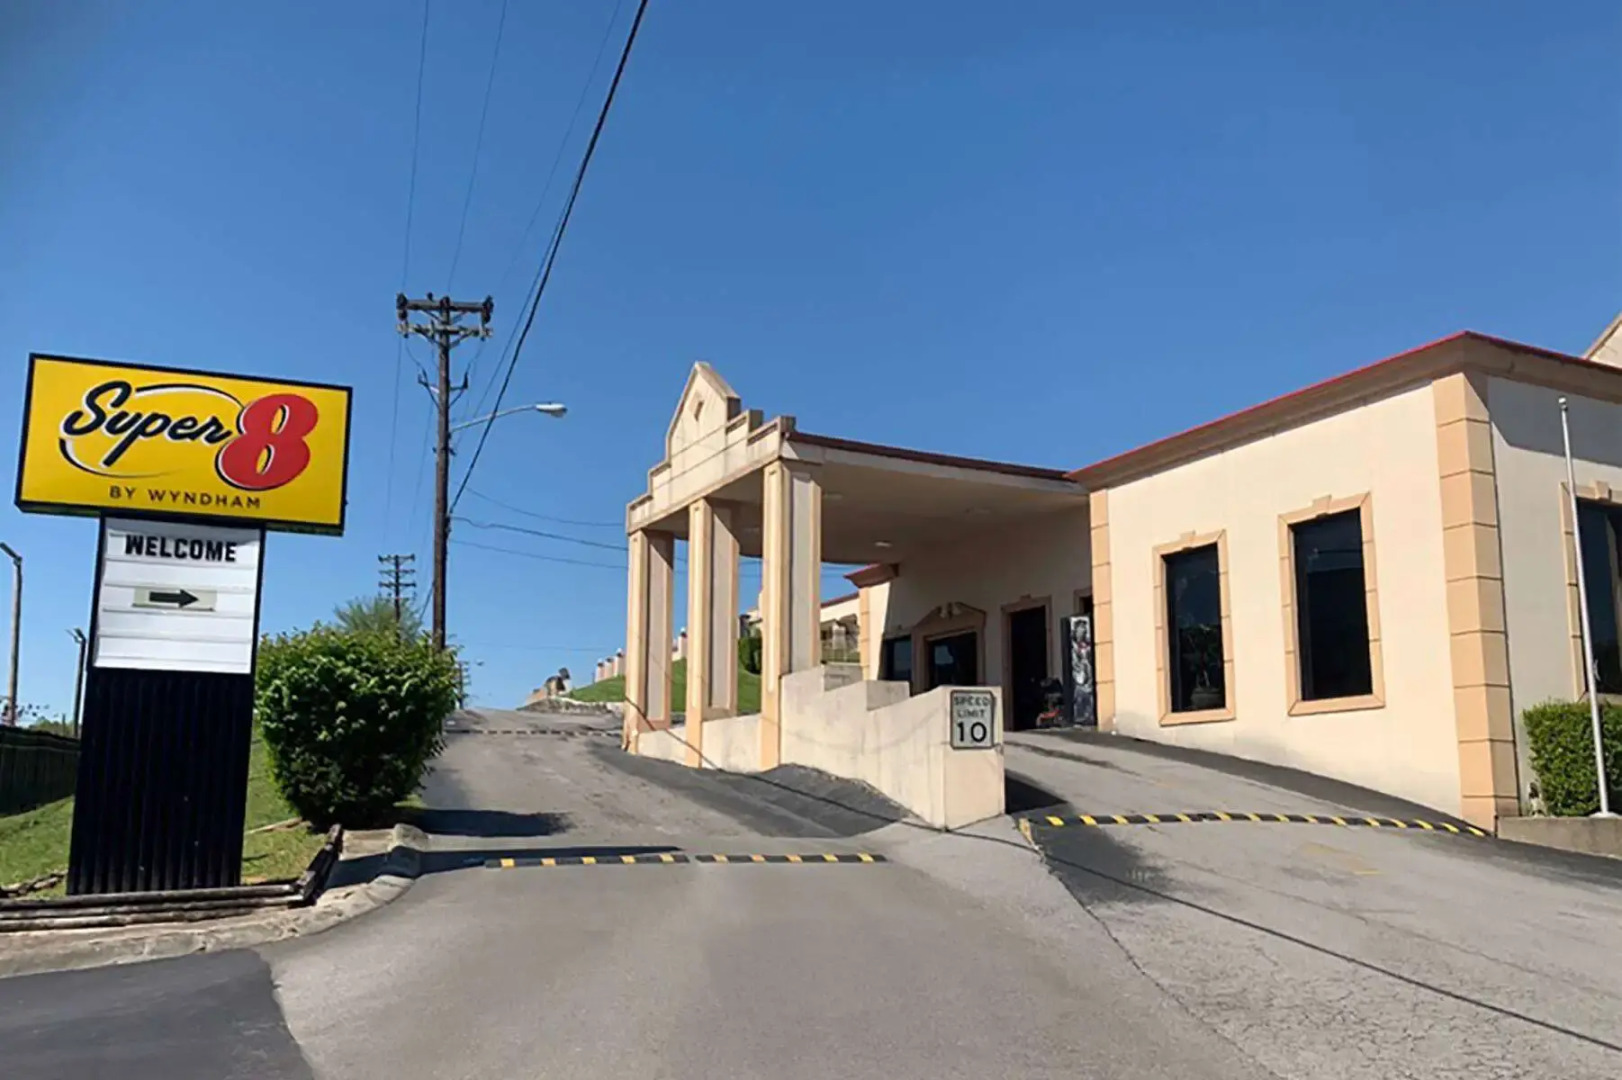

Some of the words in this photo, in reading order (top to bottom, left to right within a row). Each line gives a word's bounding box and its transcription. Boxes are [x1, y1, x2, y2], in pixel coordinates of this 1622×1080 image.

[62, 380, 233, 467] Super
[215, 393, 318, 491] 8
[109, 485, 136, 499] BY
[148, 489, 261, 509] WYNDHAM
[124, 534, 237, 562] WELCOME
[954, 695, 990, 706] SPEED
[957, 708, 985, 718] LIMIT
[957, 721, 987, 742] 10
